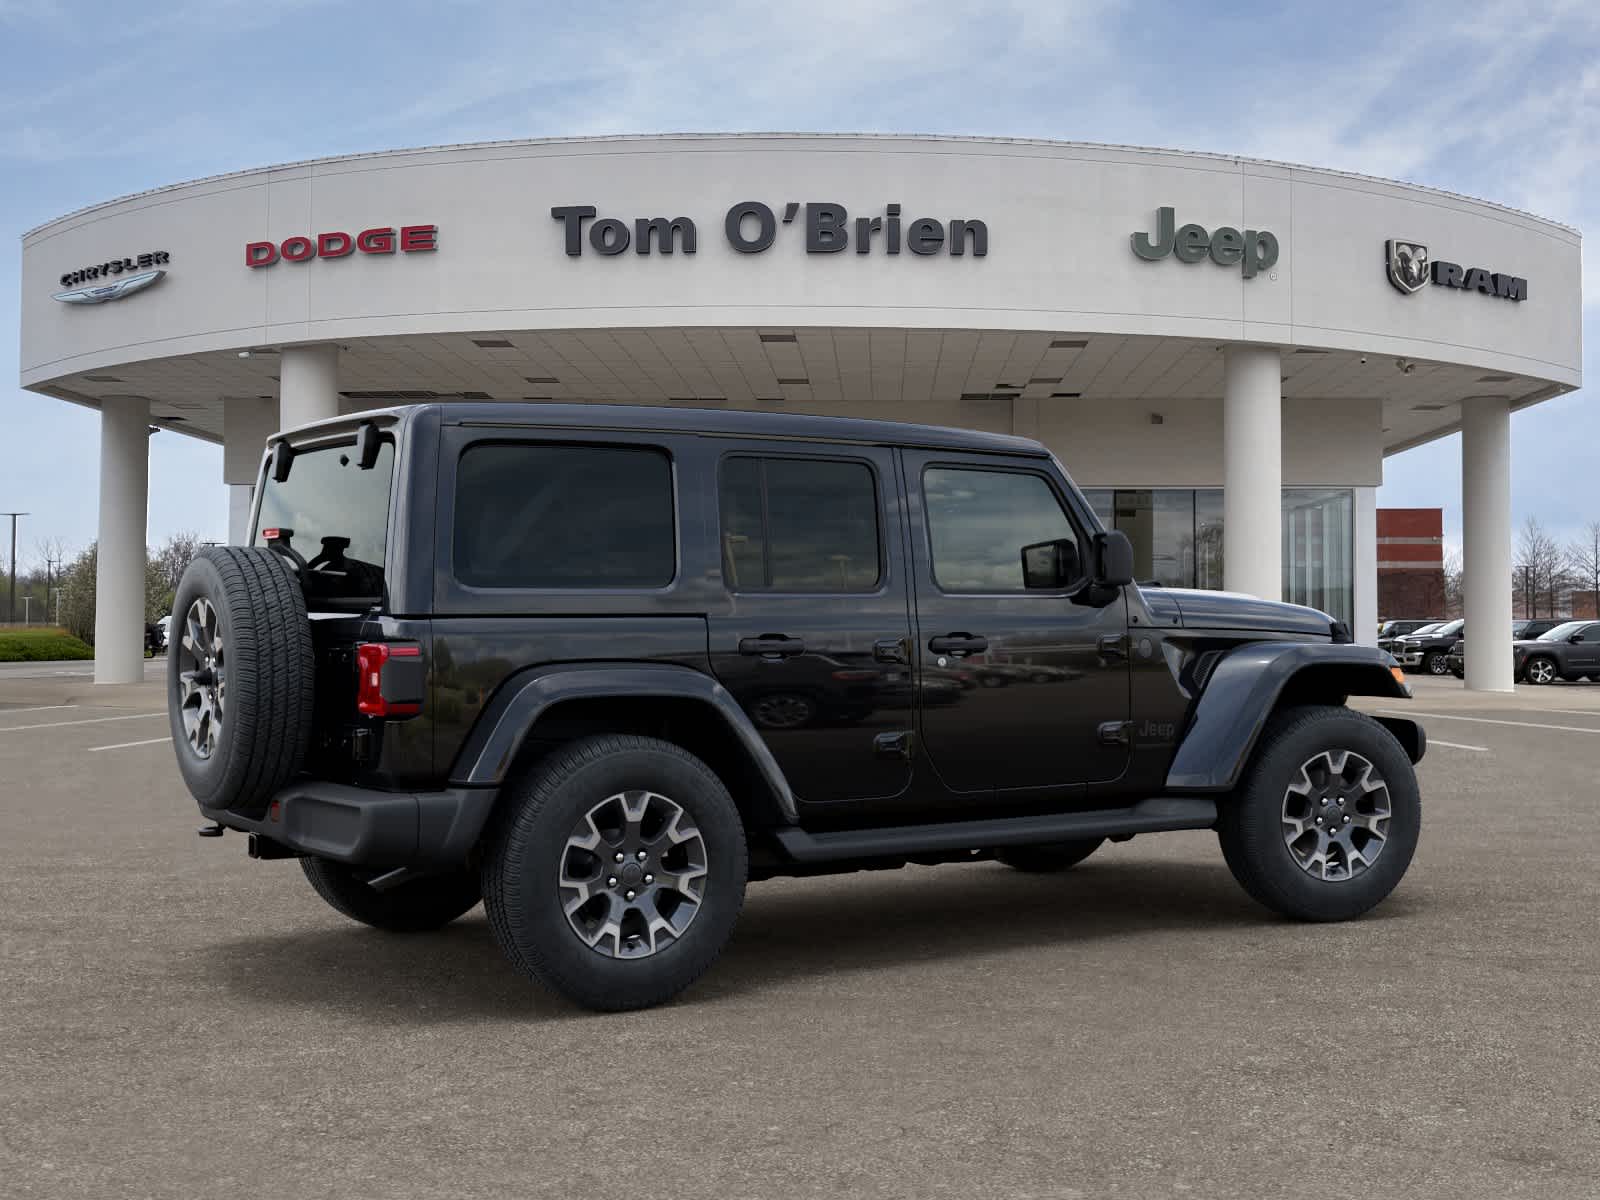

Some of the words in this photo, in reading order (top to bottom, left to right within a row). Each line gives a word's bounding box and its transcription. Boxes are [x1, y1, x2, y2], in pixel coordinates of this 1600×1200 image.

[246, 225, 437, 268] DODGE
[551, 205, 697, 256] Tom
[725, 201, 989, 257] O'Brien
[1131, 206, 1279, 279] Jeep
[60, 250, 170, 287] CHRYSLER
[1431, 260, 1528, 302] RAM
[1138, 719, 1175, 740] Jeep
